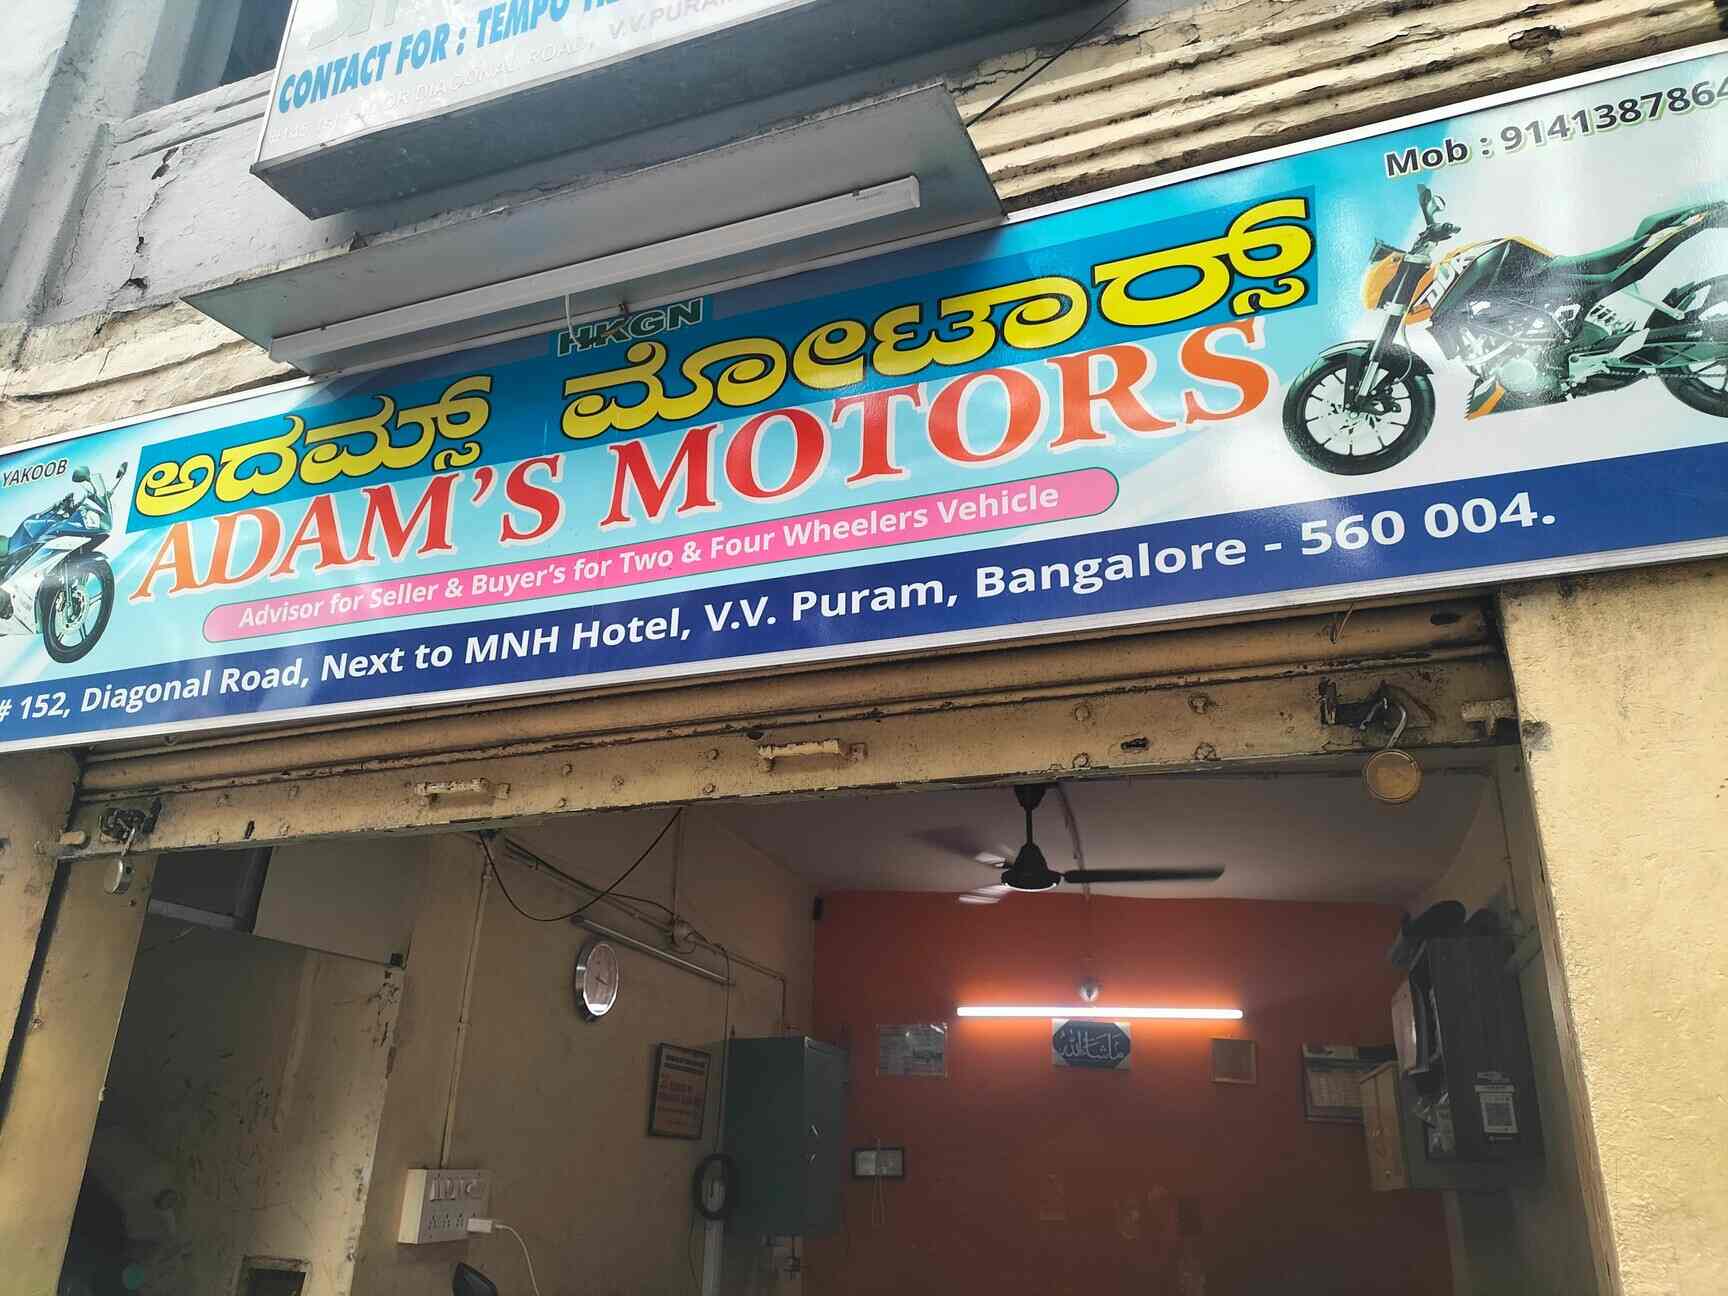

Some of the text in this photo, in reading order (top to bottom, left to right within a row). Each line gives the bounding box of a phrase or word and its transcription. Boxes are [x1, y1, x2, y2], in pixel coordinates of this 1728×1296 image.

[278, 42, 391, 113] CONTACT
[395, 23, 452, 75] FOR
[456, 27, 467, 55] :
[475, 0, 571, 49] TEMPO
[1387, 138, 1468, 177] Mob
[1480, 135, 1491, 156] :
[557, 297, 704, 357] HKGN
[560, 198, 1312, 439] ಮೋಟಾರ್ಸ್
[3, 459, 68, 487] YAKOOB
[600, 318, 1271, 527] MOTORS
[20, 691, 71, 720] 152,
[80, 669, 212, 713] Diagonal
[220, 659, 310, 695] Road,
[321, 646, 404, 682] Next
[415, 643, 452, 669] to
[464, 626, 558, 665] MNH
[572, 607, 690, 650] Hotel,
[704, 596, 776, 631] V.V.
[793, 578, 958, 622] Puram,
[976, 538, 1247, 598] Bangalore
[1301, 510, 1405, 556] 560
[1424, 491, 1556, 533] 004.
[238, 602, 323, 629] Advisor
[329, 592, 366, 616] for
[369, 583, 438, 608] Seller
[444, 580, 465, 598] &
[573, 556, 612, 579] for
[620, 549, 673, 574] Two
[680, 541, 702, 562] &
[710, 532, 776, 560] Four
[783, 512, 928, 547] Wheelers
[937, 485, 1059, 524] Vehicle
